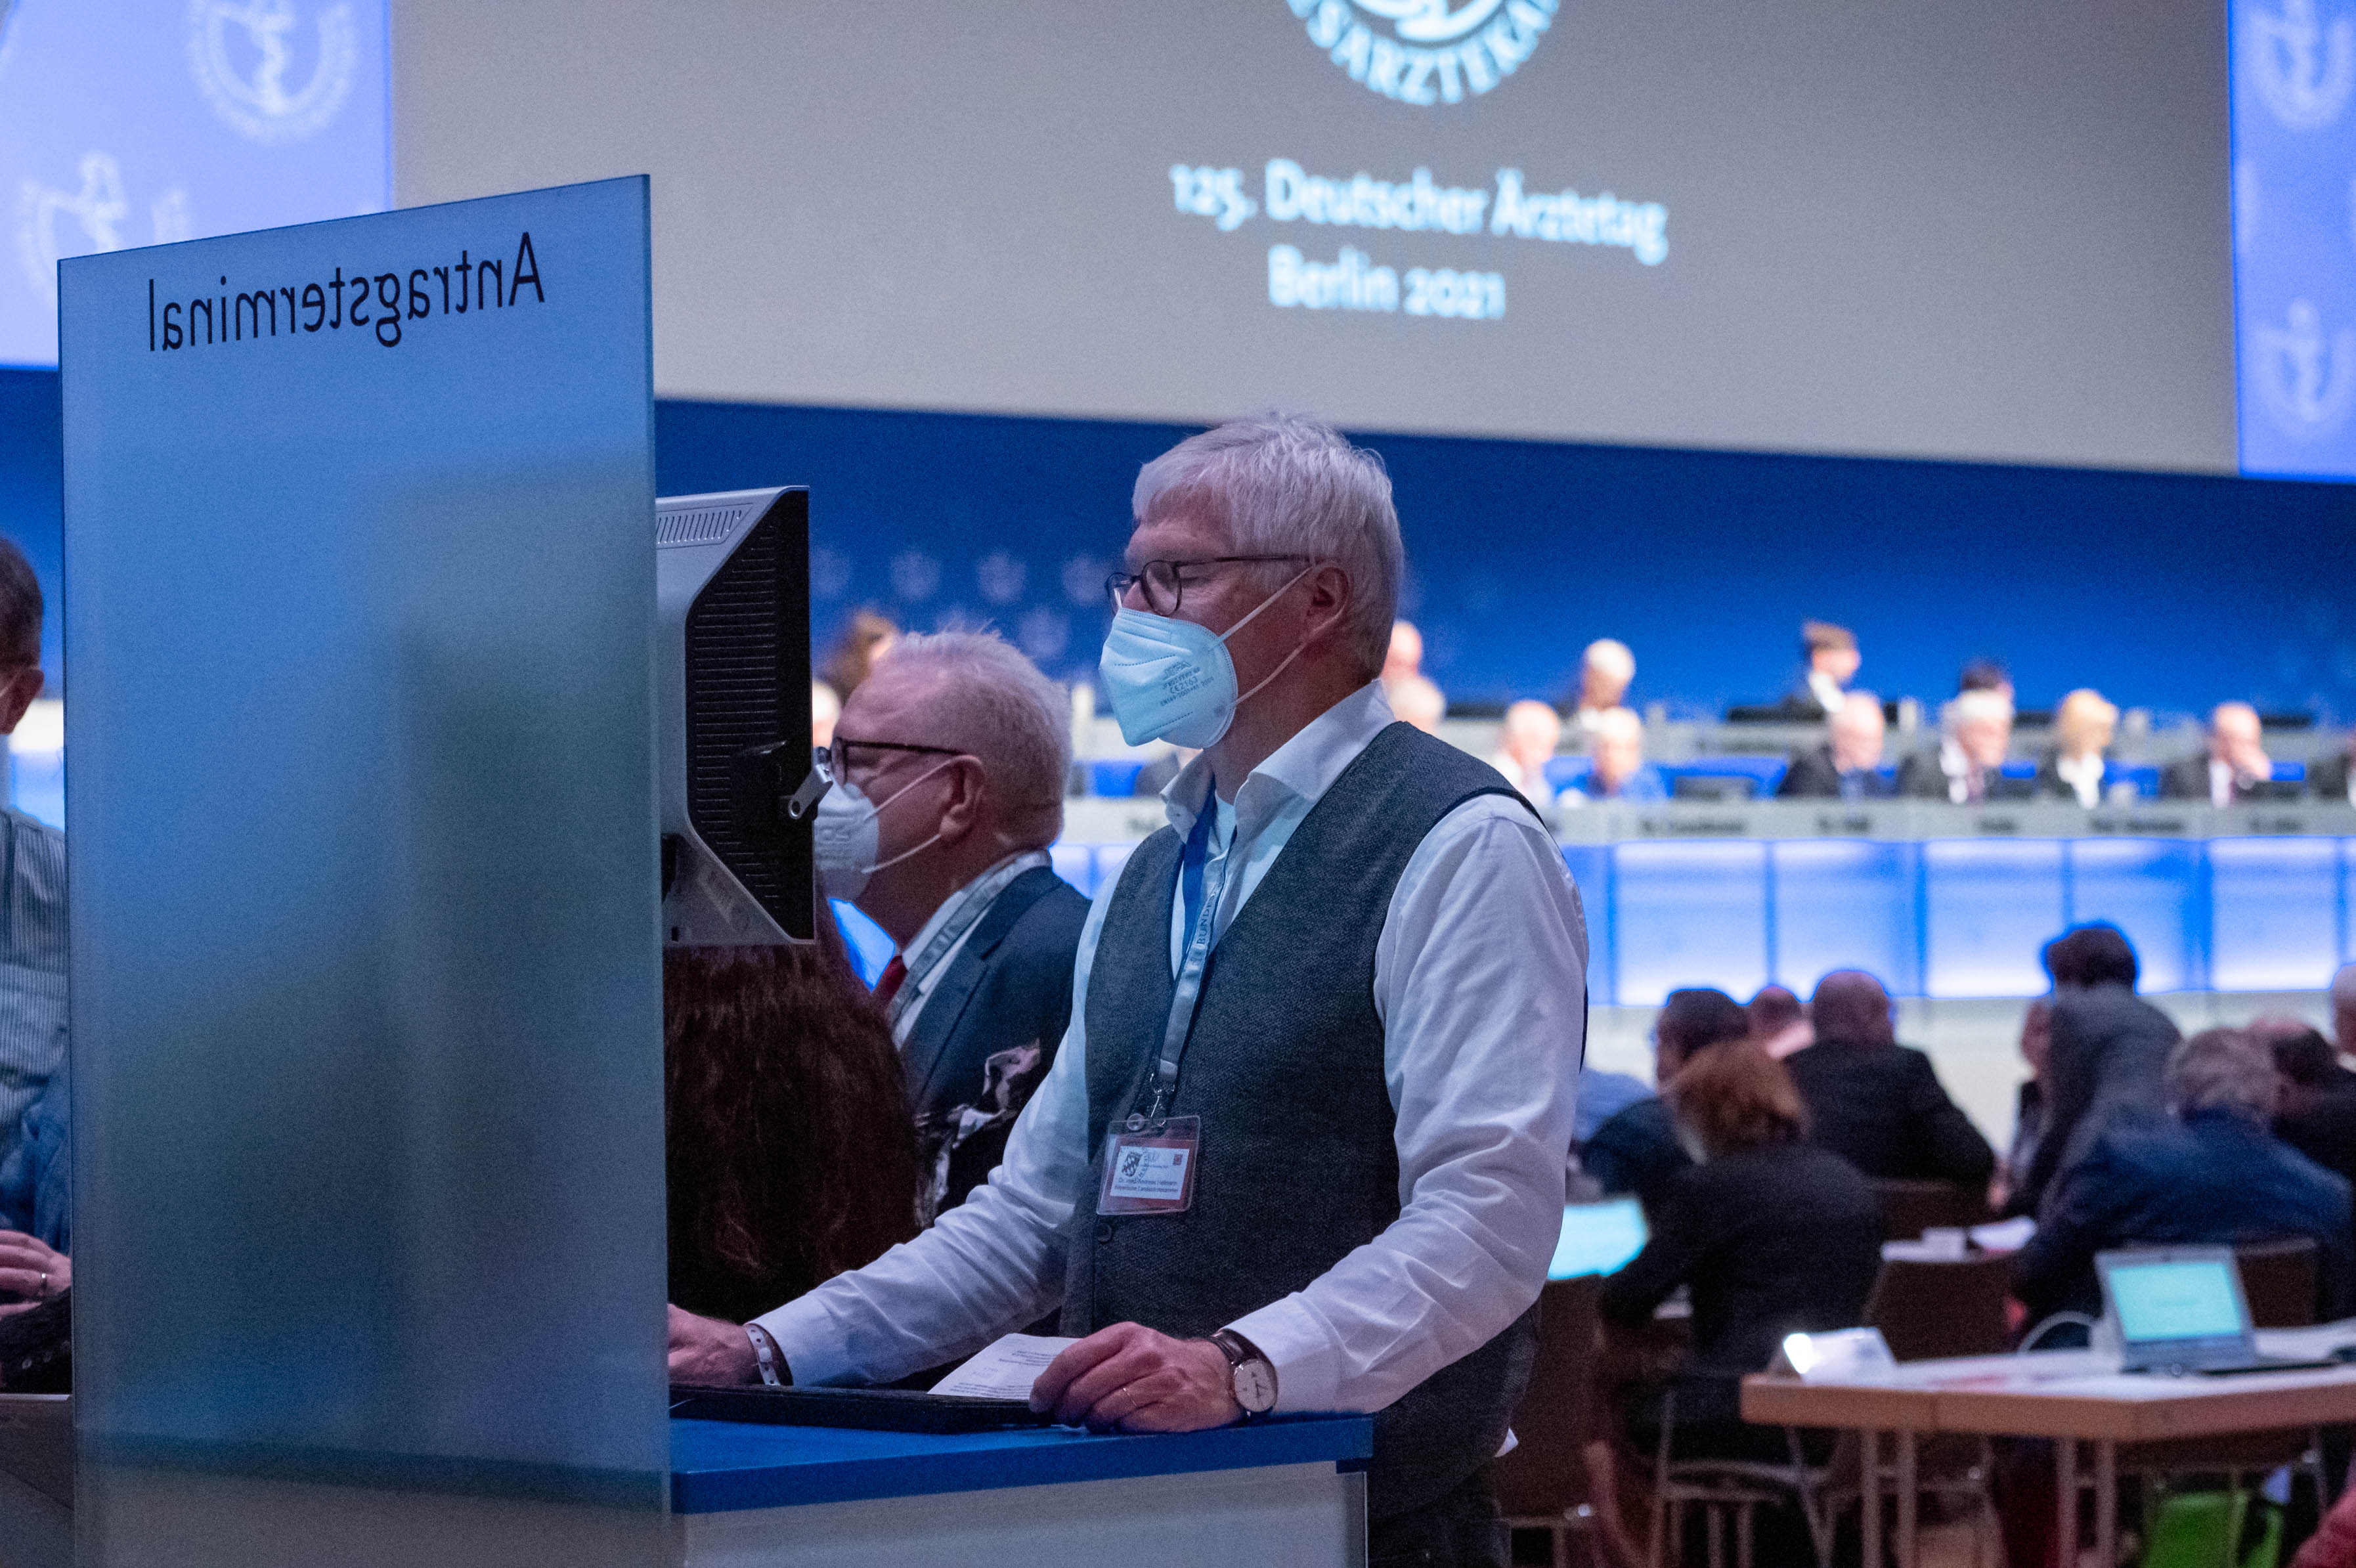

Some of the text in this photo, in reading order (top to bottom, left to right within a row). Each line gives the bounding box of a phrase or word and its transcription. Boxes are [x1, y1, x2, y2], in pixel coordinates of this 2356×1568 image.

[1265, 159, 1489, 234] Deutscher
[1267, 244, 1506, 319] Berlin 2021
